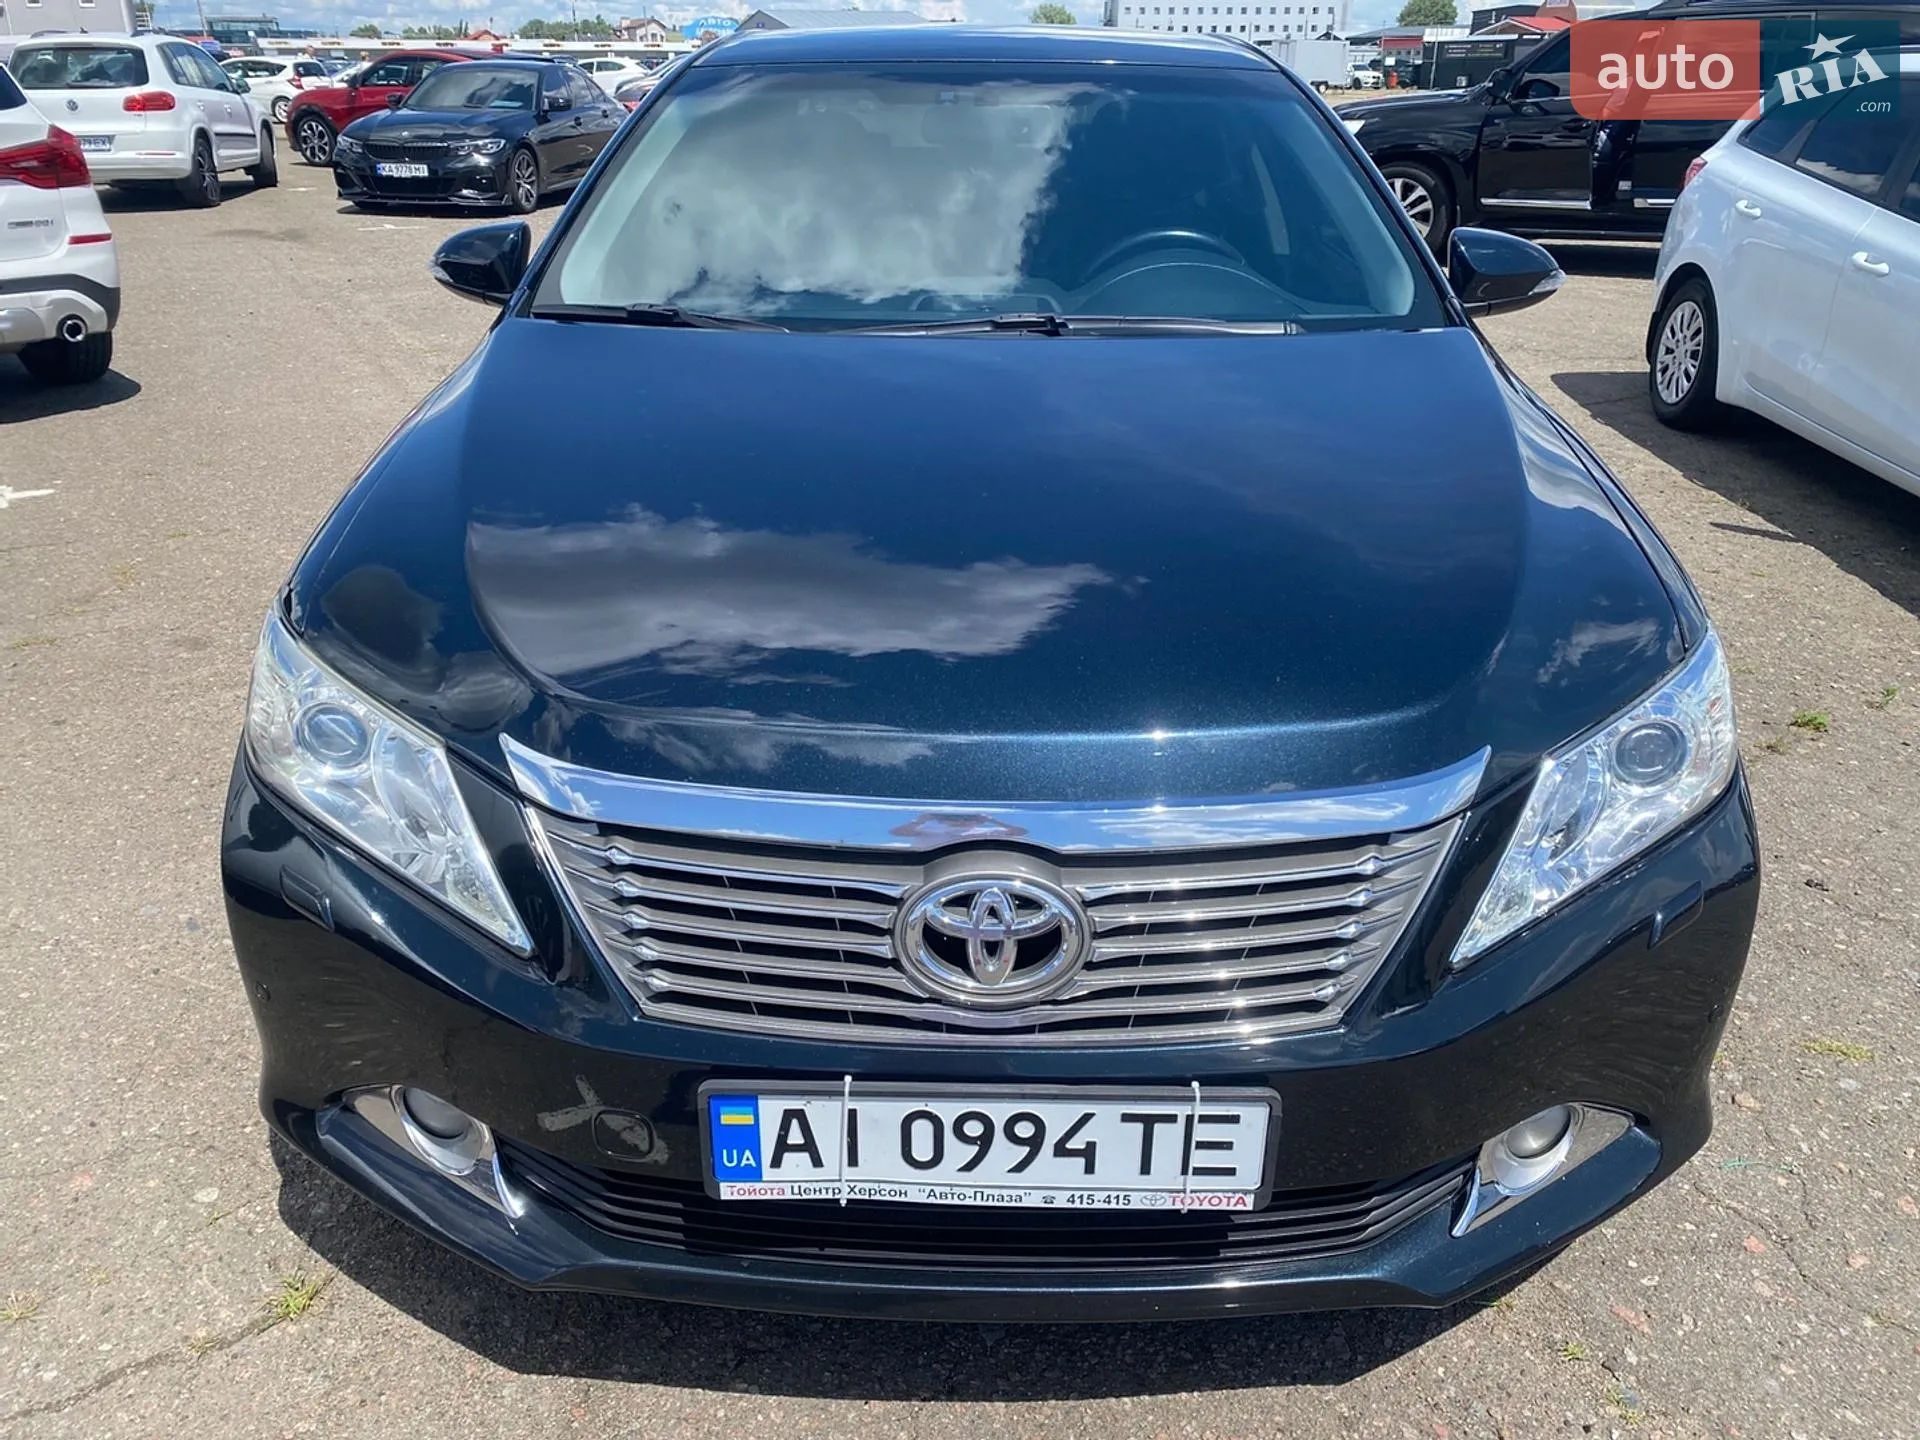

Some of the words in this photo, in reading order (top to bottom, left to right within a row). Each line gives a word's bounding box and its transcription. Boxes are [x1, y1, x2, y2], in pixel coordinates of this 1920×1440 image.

[770, 1108, 858, 1169] AI
[900, 1109, 1097, 1175] 0994
[1120, 1112, 1241, 1176] TE
[722, 1149, 757, 1168] UA
[727, 1184, 785, 1196] Тойота
[790, 1184, 842, 1199] Центр
[847, 1184, 908, 1201] Херсон
[1066, 1194, 1131, 1206] 415-415
[1171, 1195, 1248, 1208] TOYOTA
